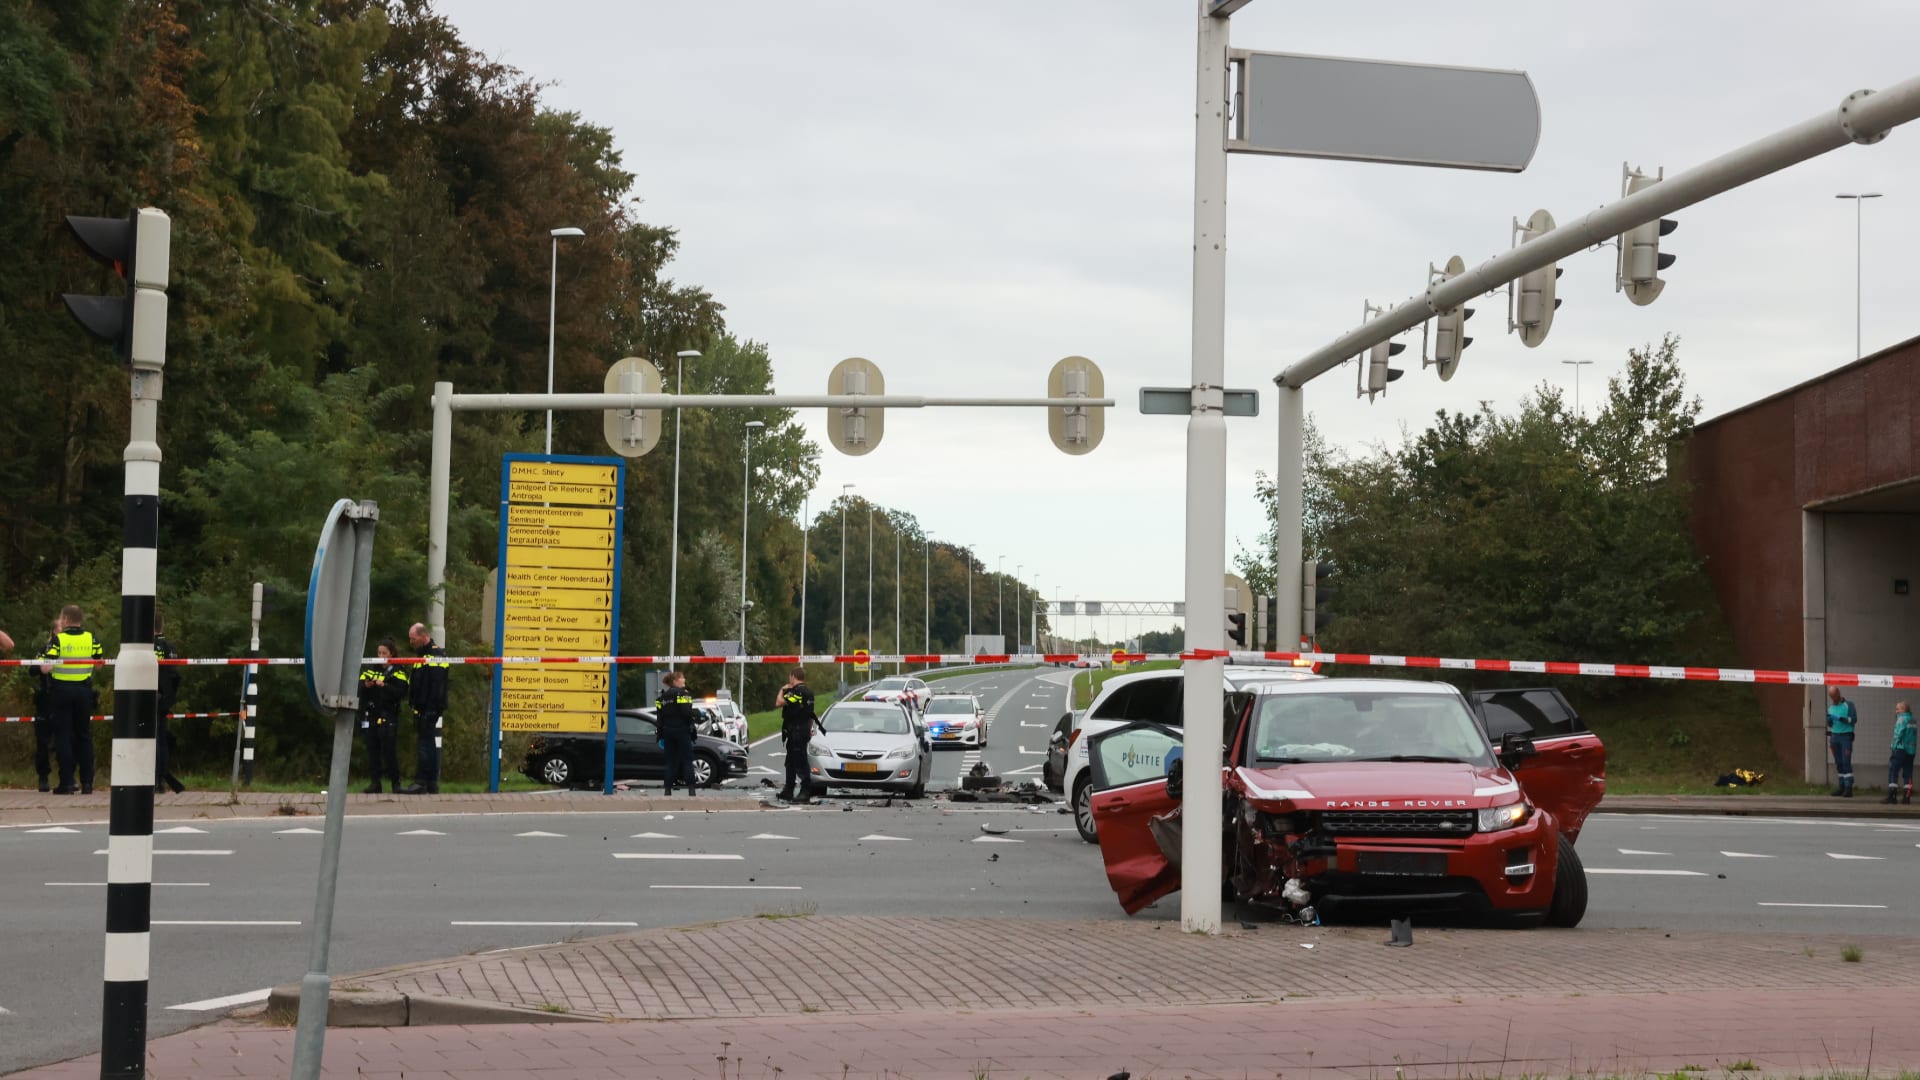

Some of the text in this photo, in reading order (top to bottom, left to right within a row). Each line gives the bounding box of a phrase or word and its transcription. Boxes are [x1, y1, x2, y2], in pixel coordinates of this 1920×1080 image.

[542, 468, 565, 476] Shinty
[511, 483, 547, 493] Landgoed
[511, 492, 543, 501] Antropia
[510, 507, 584, 517] Evenemententerrein
[509, 516, 545, 524] Seminarie
[509, 527, 560, 537] Gemeentelijke
[509, 536, 560, 545] begraafplaats
[507, 572, 605, 583] Health Center Hoenderdaal
[505, 614, 541, 622] Zwembad
[555, 615, 579, 624] Zwoer
[505, 634, 541, 643] Sportpark
[556, 635, 580, 643] Woerd
[503, 675, 514, 683] De
[515, 676, 541, 685] Bergse
[503, 692, 544, 700] Restaurant
[522, 702, 565, 710] Zwitserland
[501, 712, 537, 720] Landgoed
[501, 722, 560, 730] Kraaybeekerhof
[1122, 744, 1160, 768] POLITIE
